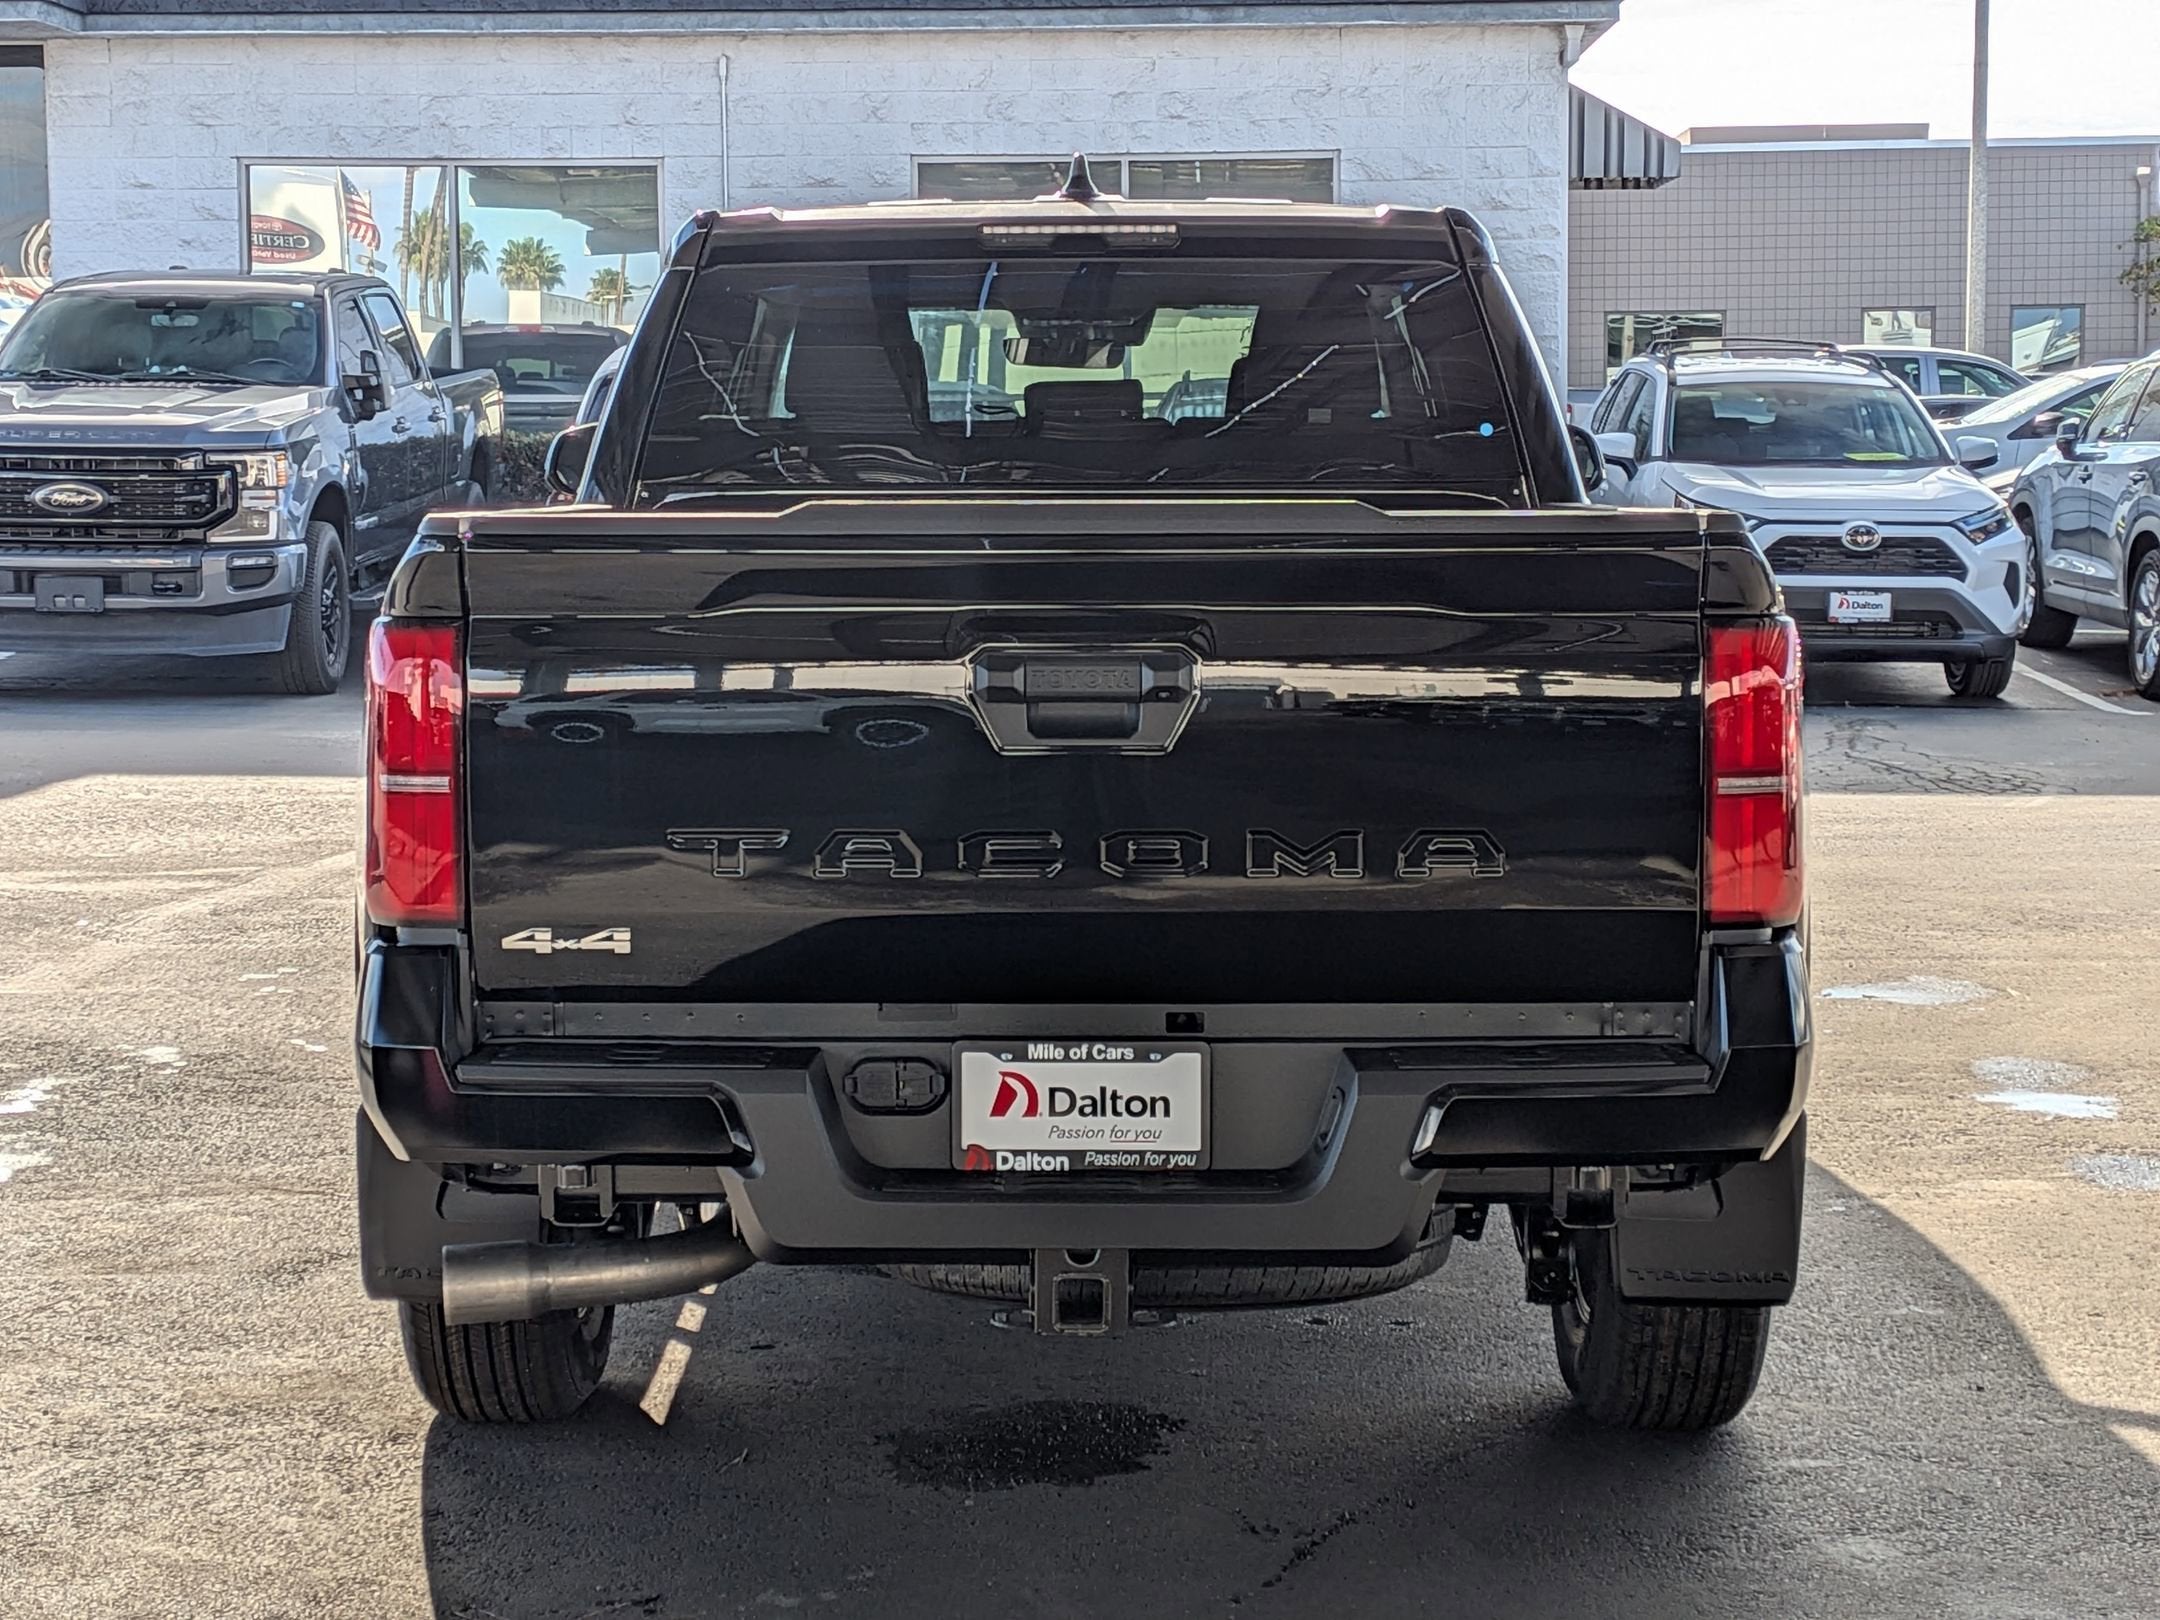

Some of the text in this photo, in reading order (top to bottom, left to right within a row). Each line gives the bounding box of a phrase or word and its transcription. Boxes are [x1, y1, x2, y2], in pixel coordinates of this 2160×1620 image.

[1851, 601, 1883, 609] Dalton
[1031, 669, 1135, 688] TOYOTA
[665, 828, 1506, 879] TACOMA
[501, 927, 632, 954] 4x4
[1028, 1043, 1135, 1060] Mile of Cars
[1048, 1086, 1171, 1118] Dalton
[1048, 1125, 1162, 1142] Passion for you
[996, 1151, 1197, 1171] Dalton Passion for you
[1626, 1267, 1791, 1283] TACOMA
